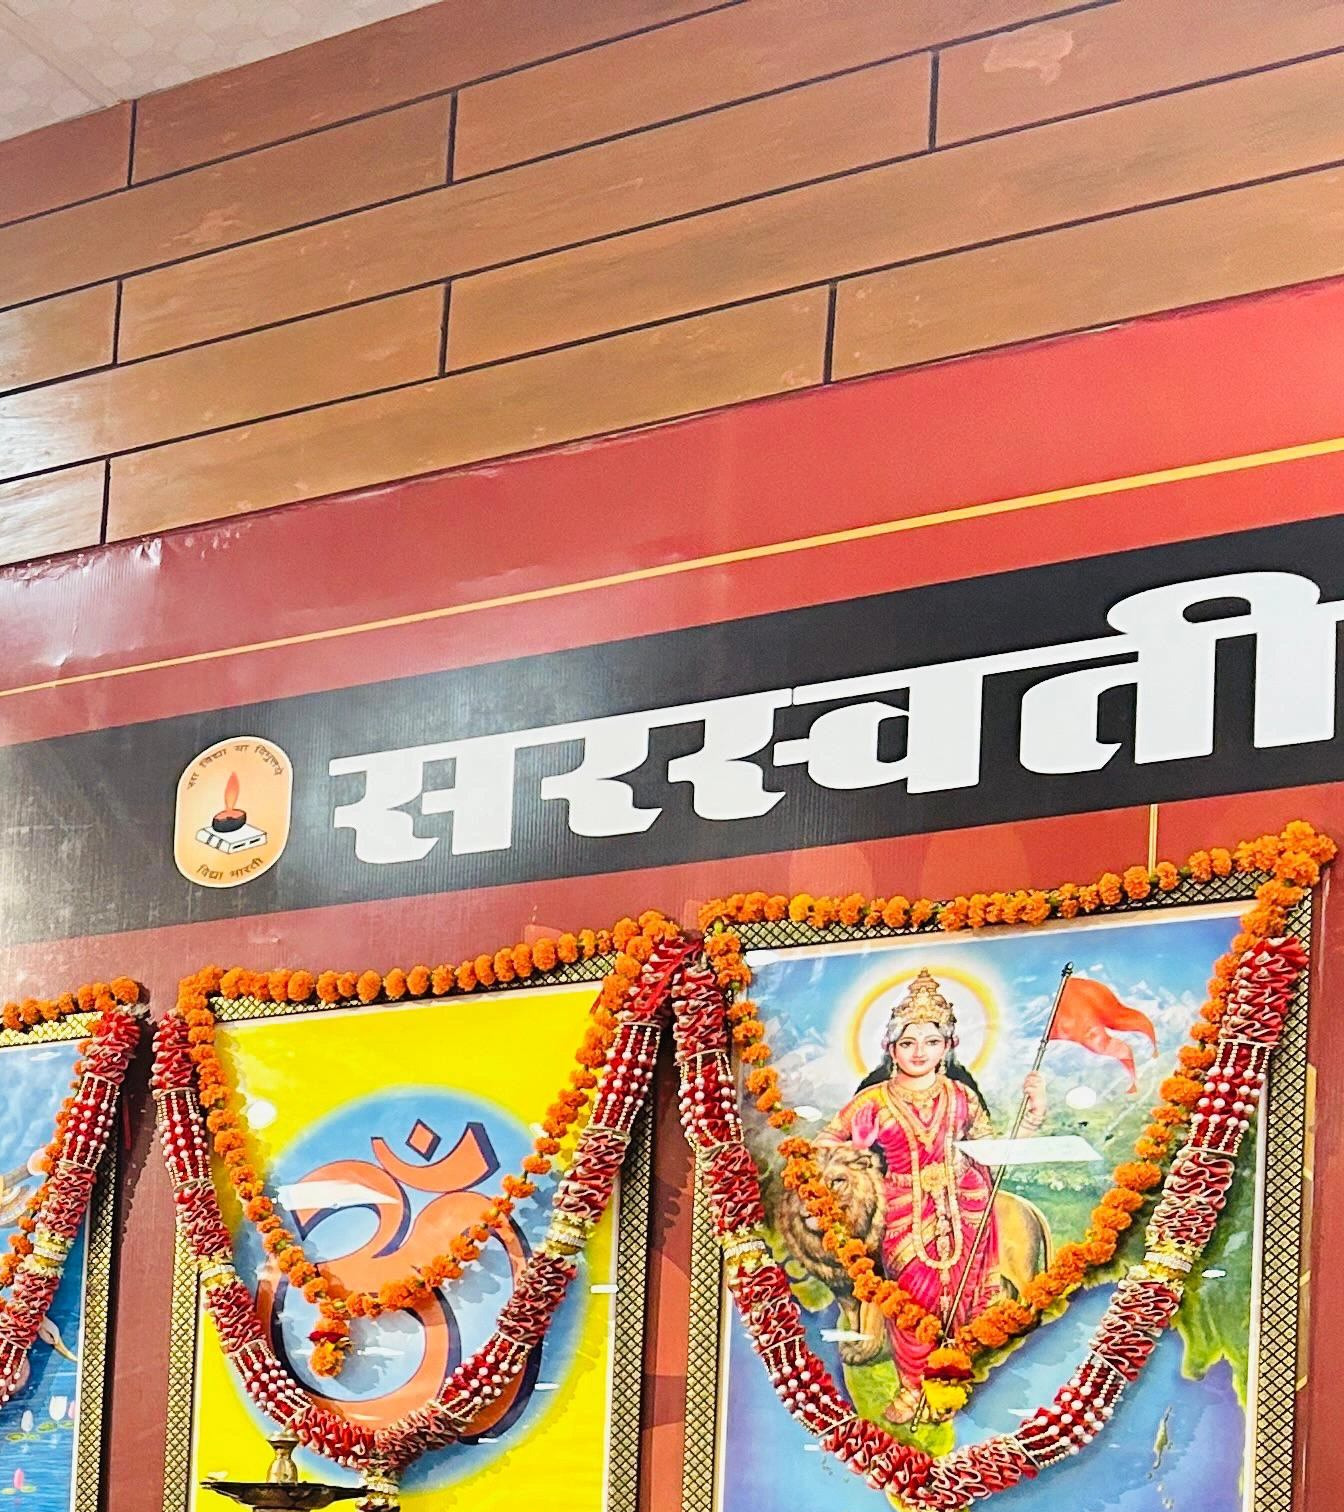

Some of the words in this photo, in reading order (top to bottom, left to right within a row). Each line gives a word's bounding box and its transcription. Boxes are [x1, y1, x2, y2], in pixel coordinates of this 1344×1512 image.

[330, 571, 1344, 866] सरस्वती
[196, 863, 223, 880] विद्या
[229, 857, 263, 878] भारती
